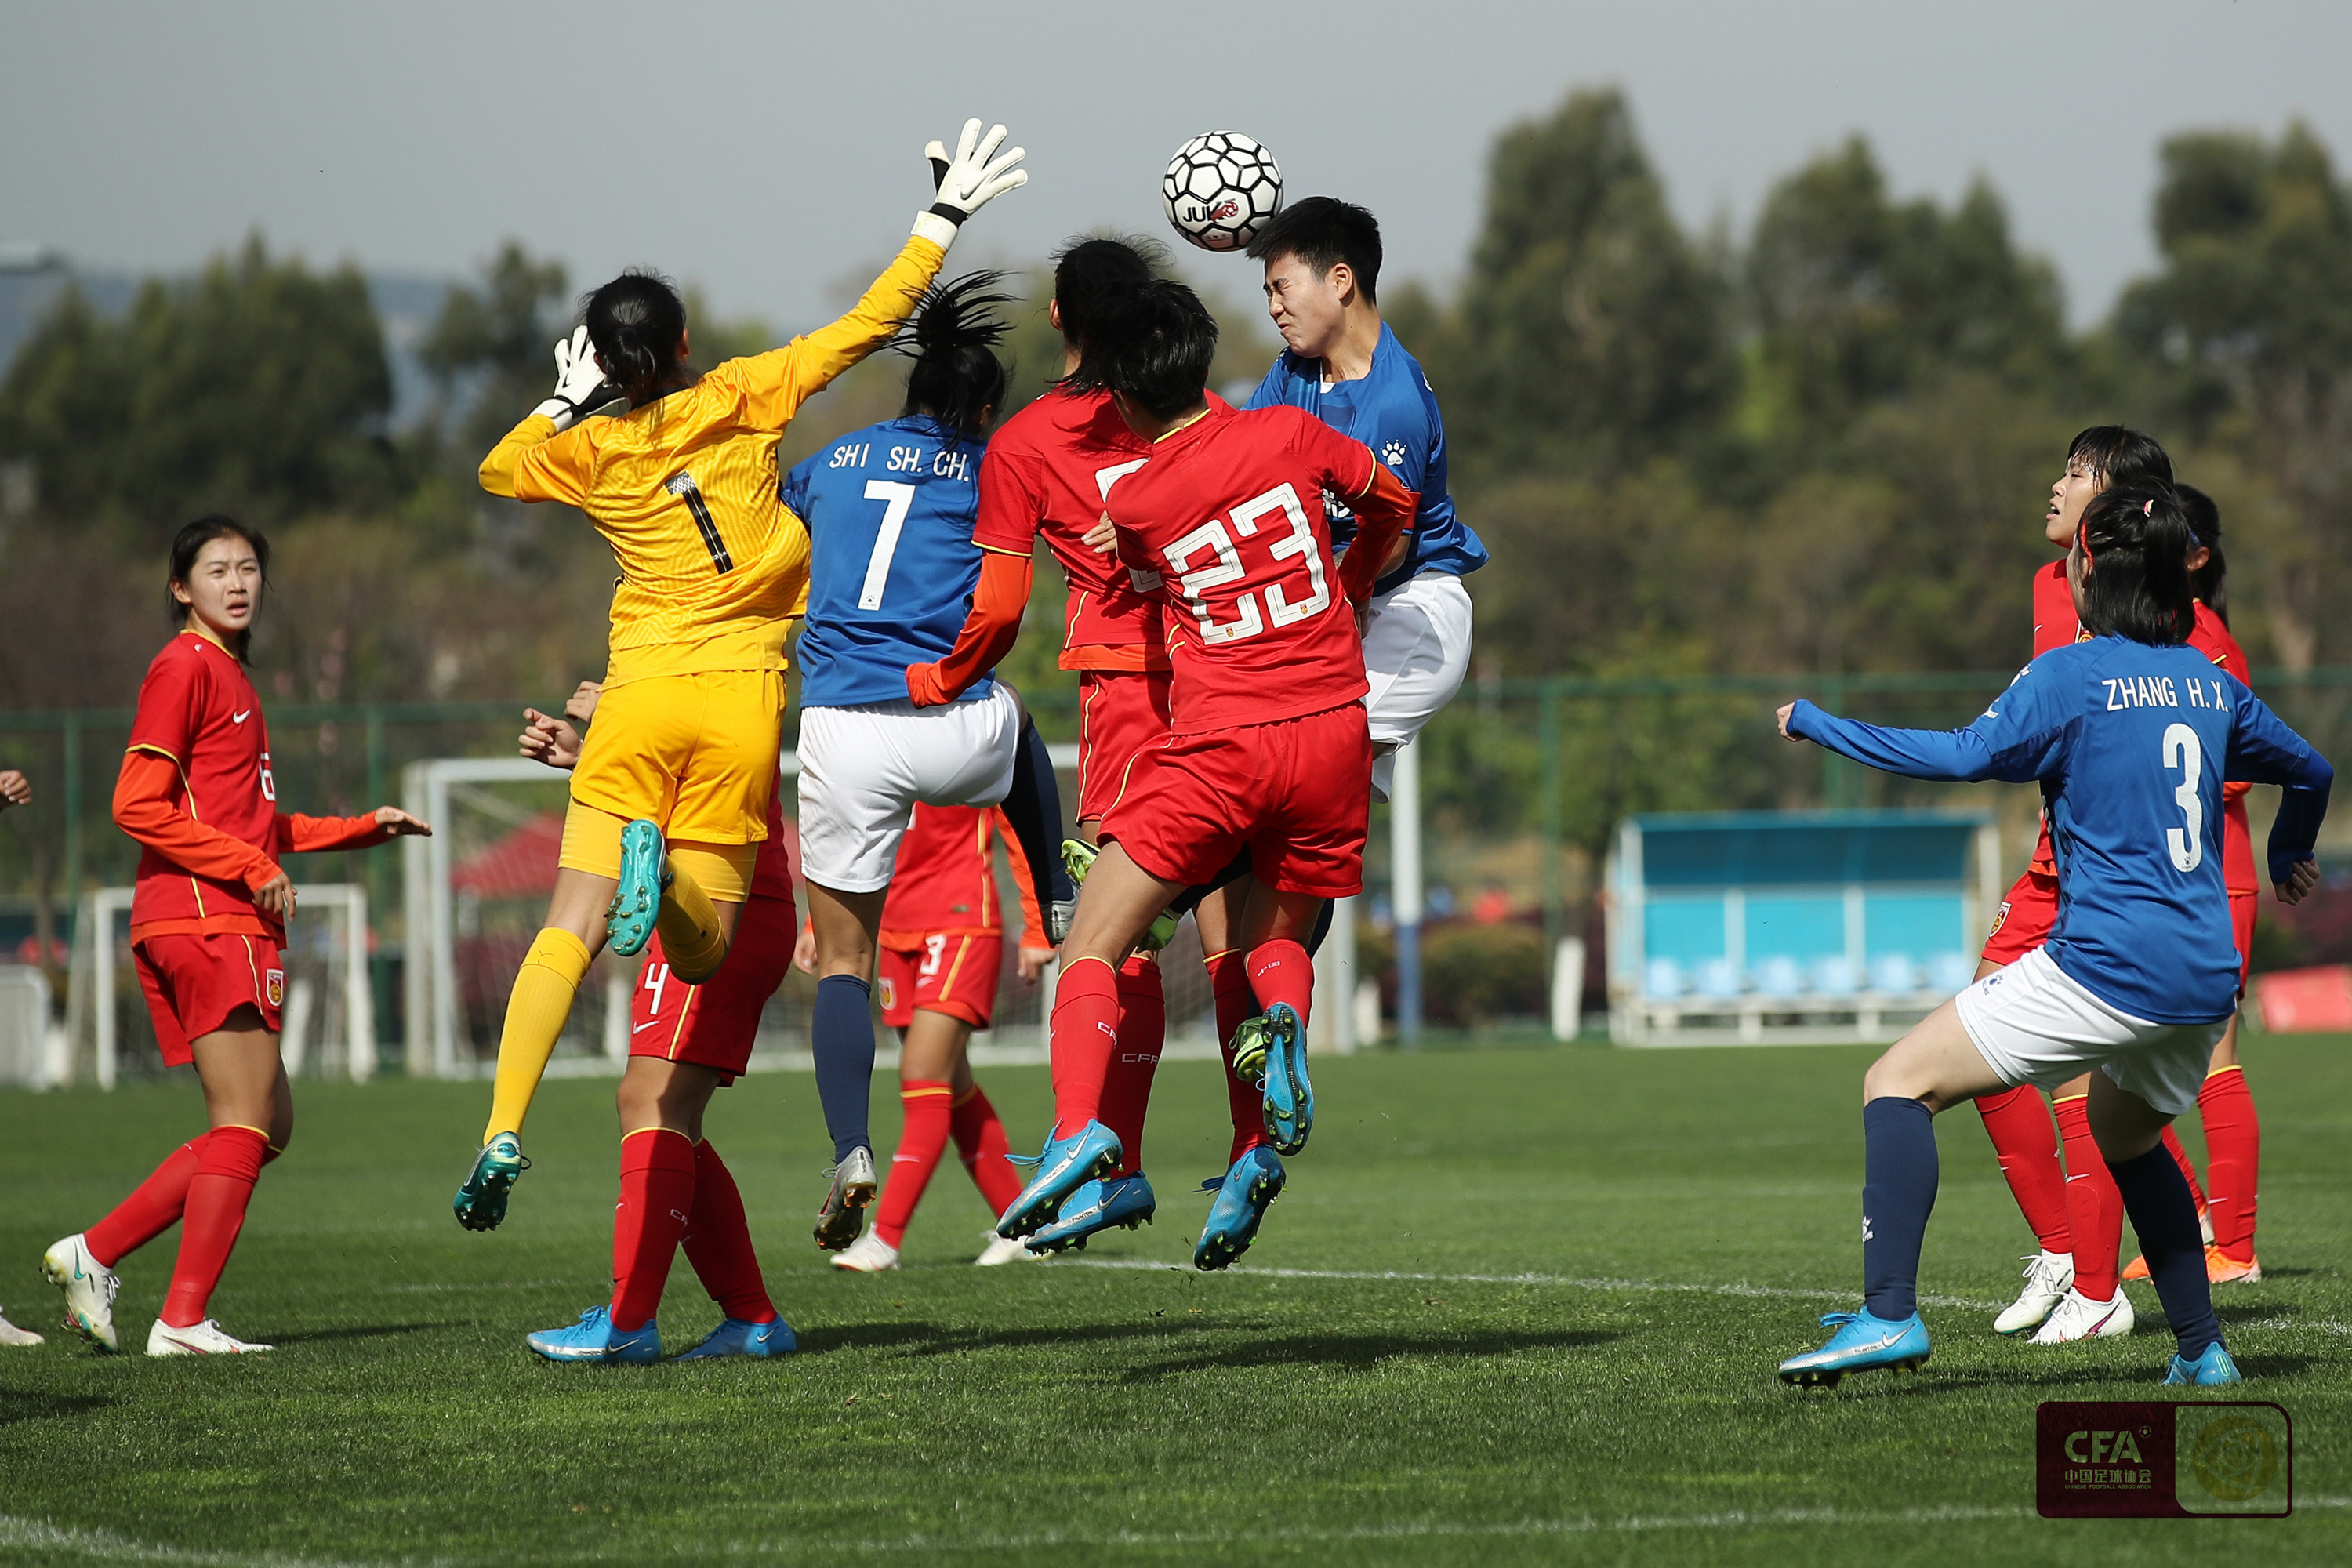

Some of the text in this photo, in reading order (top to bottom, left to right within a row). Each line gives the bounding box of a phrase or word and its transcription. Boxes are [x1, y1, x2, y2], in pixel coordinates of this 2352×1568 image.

[829, 443, 970, 482] SHI SH. CH.
[664, 470, 735, 575] 1
[858, 479, 916, 612] 7
[1162, 481, 1330, 645] 23
[2101, 676, 2229, 713] ZHANG H. X.
[2163, 723, 2203, 873] 3
[644, 963, 670, 1015] 4
[920, 934, 947, 975] 3
